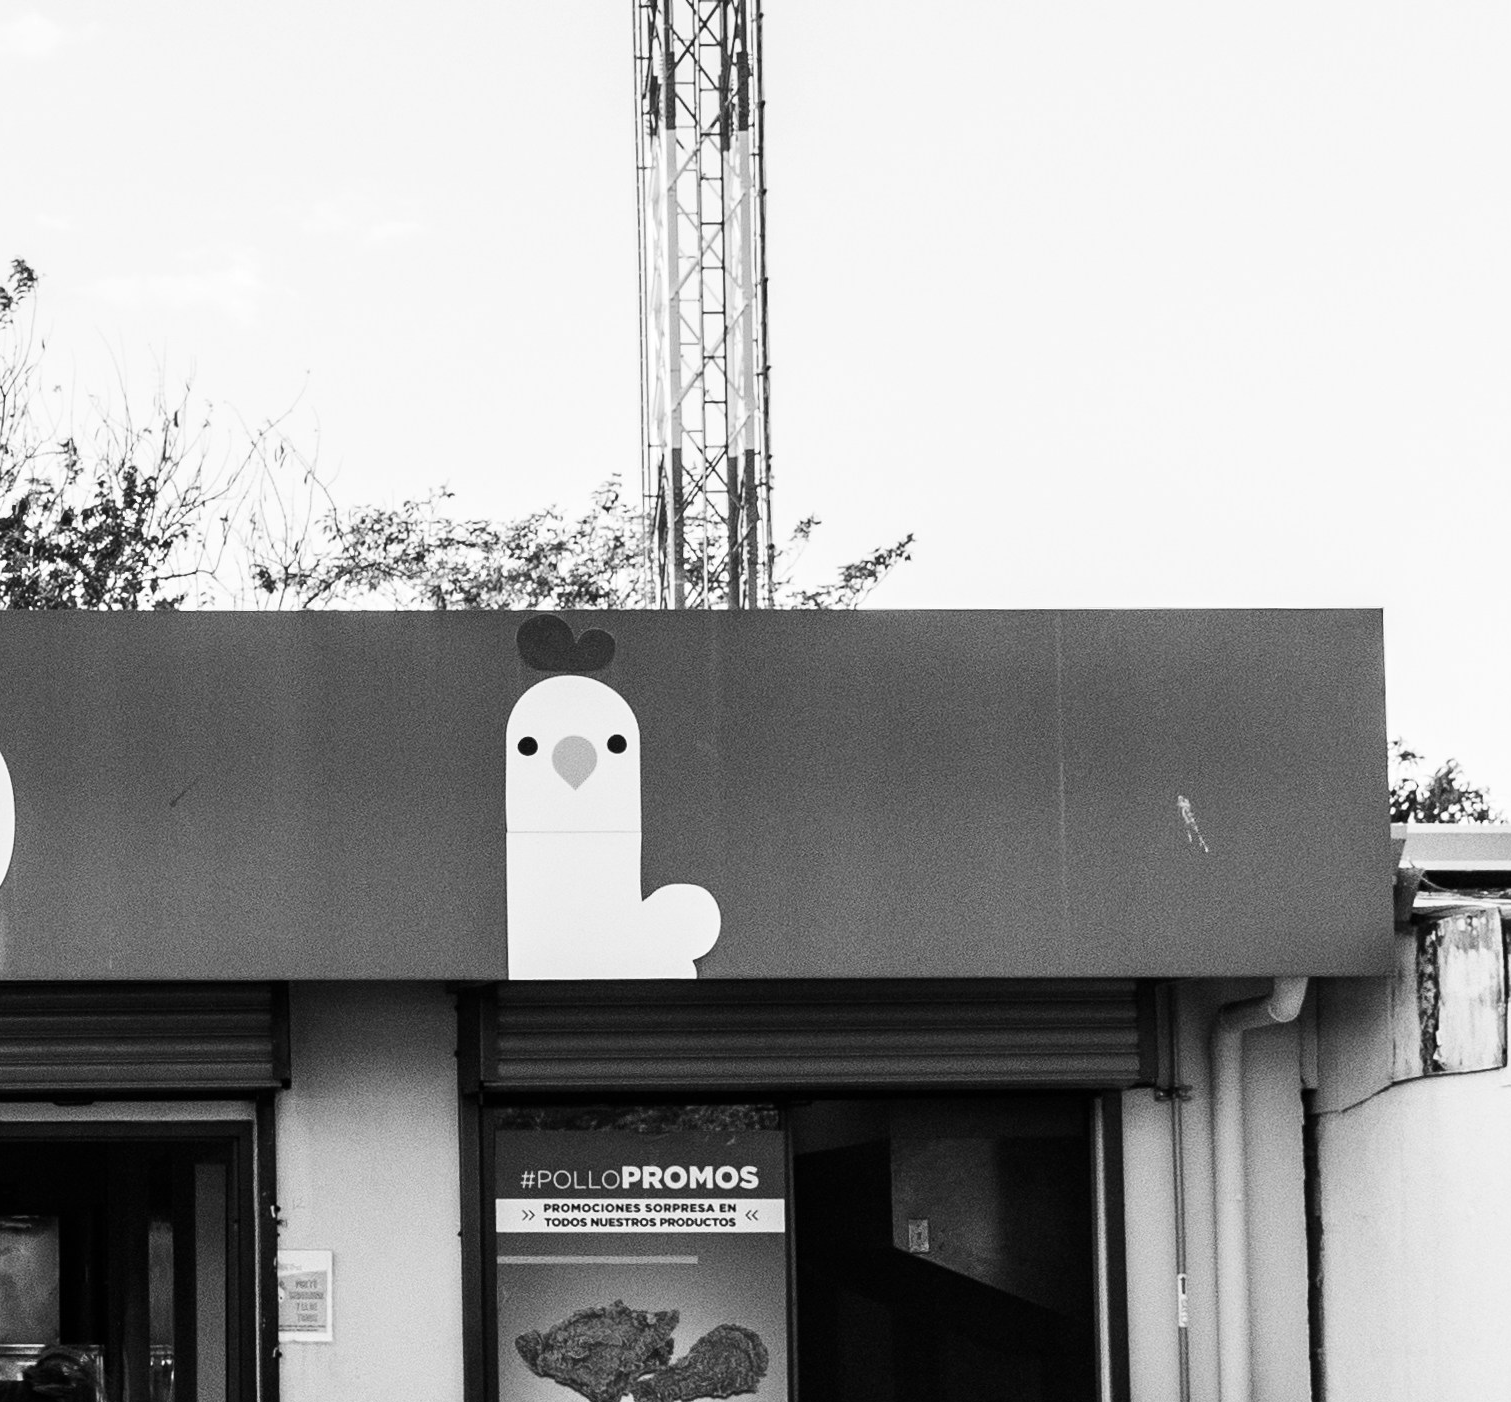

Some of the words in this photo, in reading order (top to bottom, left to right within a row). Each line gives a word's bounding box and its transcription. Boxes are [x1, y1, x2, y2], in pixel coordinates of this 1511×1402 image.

[520, 1165, 760, 1190] #POLLOPROMOS
[543, 1203, 641, 1214] PROMOCIONES
[644, 1203, 716, 1214] SORPRESA
[718, 1203, 737, 1214] EN
[544, 1217, 586, 1228] TODOS
[590, 1217, 656, 1228] NUESTROS
[659, 1217, 736, 1228] PRODUCTOS
